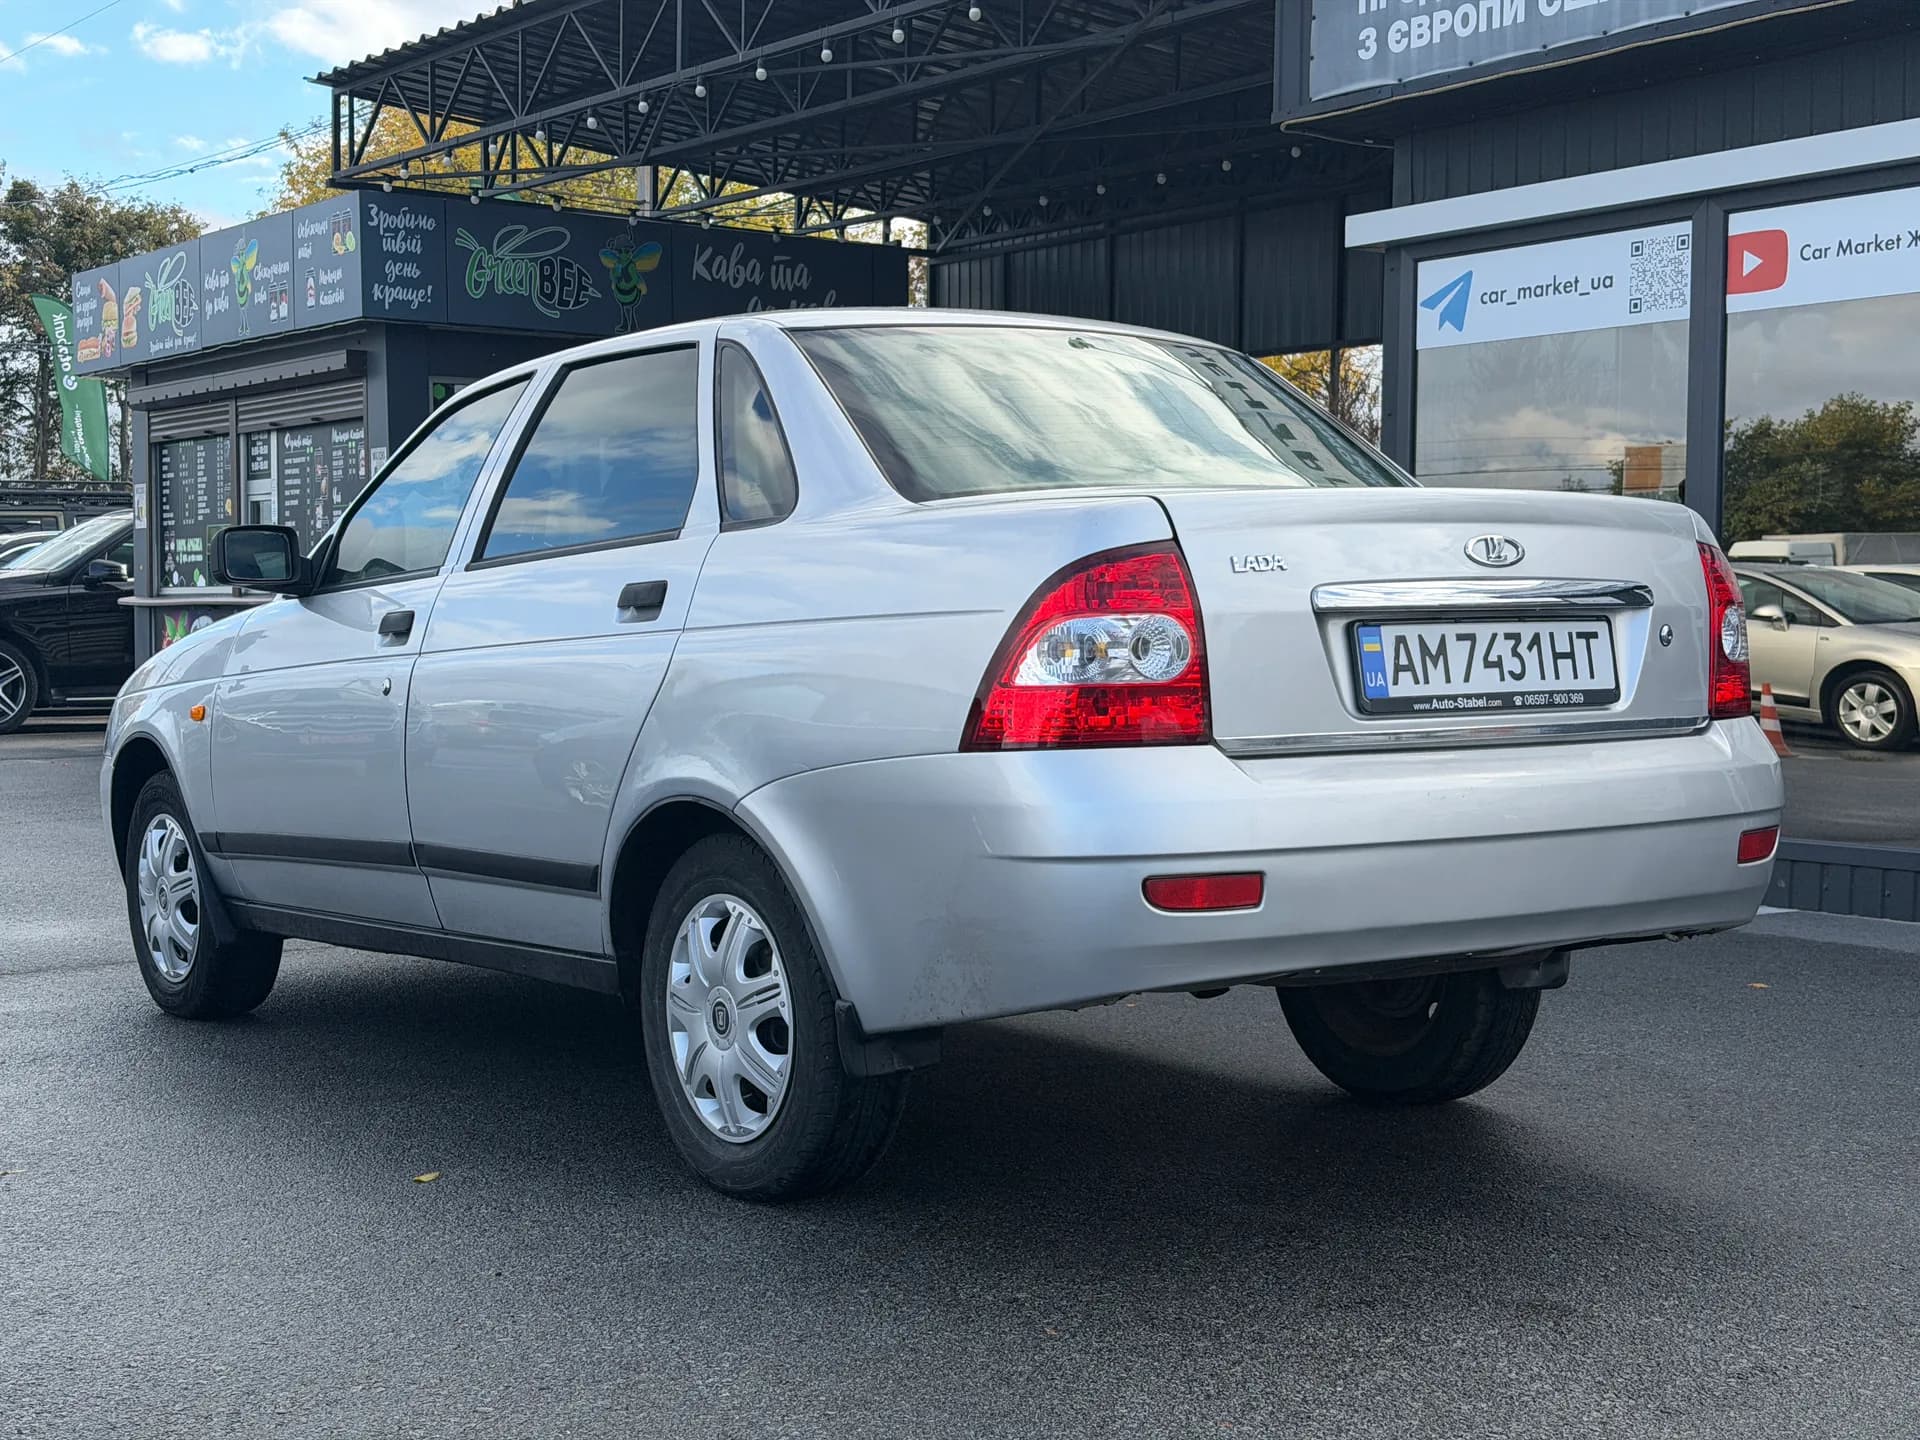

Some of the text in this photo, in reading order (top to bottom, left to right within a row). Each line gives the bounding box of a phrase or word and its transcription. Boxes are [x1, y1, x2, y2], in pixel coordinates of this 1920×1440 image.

[1357, 0, 1526, 60] З ЄВРОПИ
[367, 203, 437, 236] Зробимо
[382, 230, 423, 254] твій
[1799, 243, 1832, 262] Car
[1836, 233, 1903, 258] Market
[384, 259, 422, 283] день
[692, 242, 812, 291] Кава та
[372, 283, 433, 310] краще!
[1480, 275, 1614, 306] car_market_ua
[1230, 554, 1288, 574] LADA
[1366, 672, 1386, 688] UA
[1413, 696, 1503, 711] www.Auto-Stabel.com
